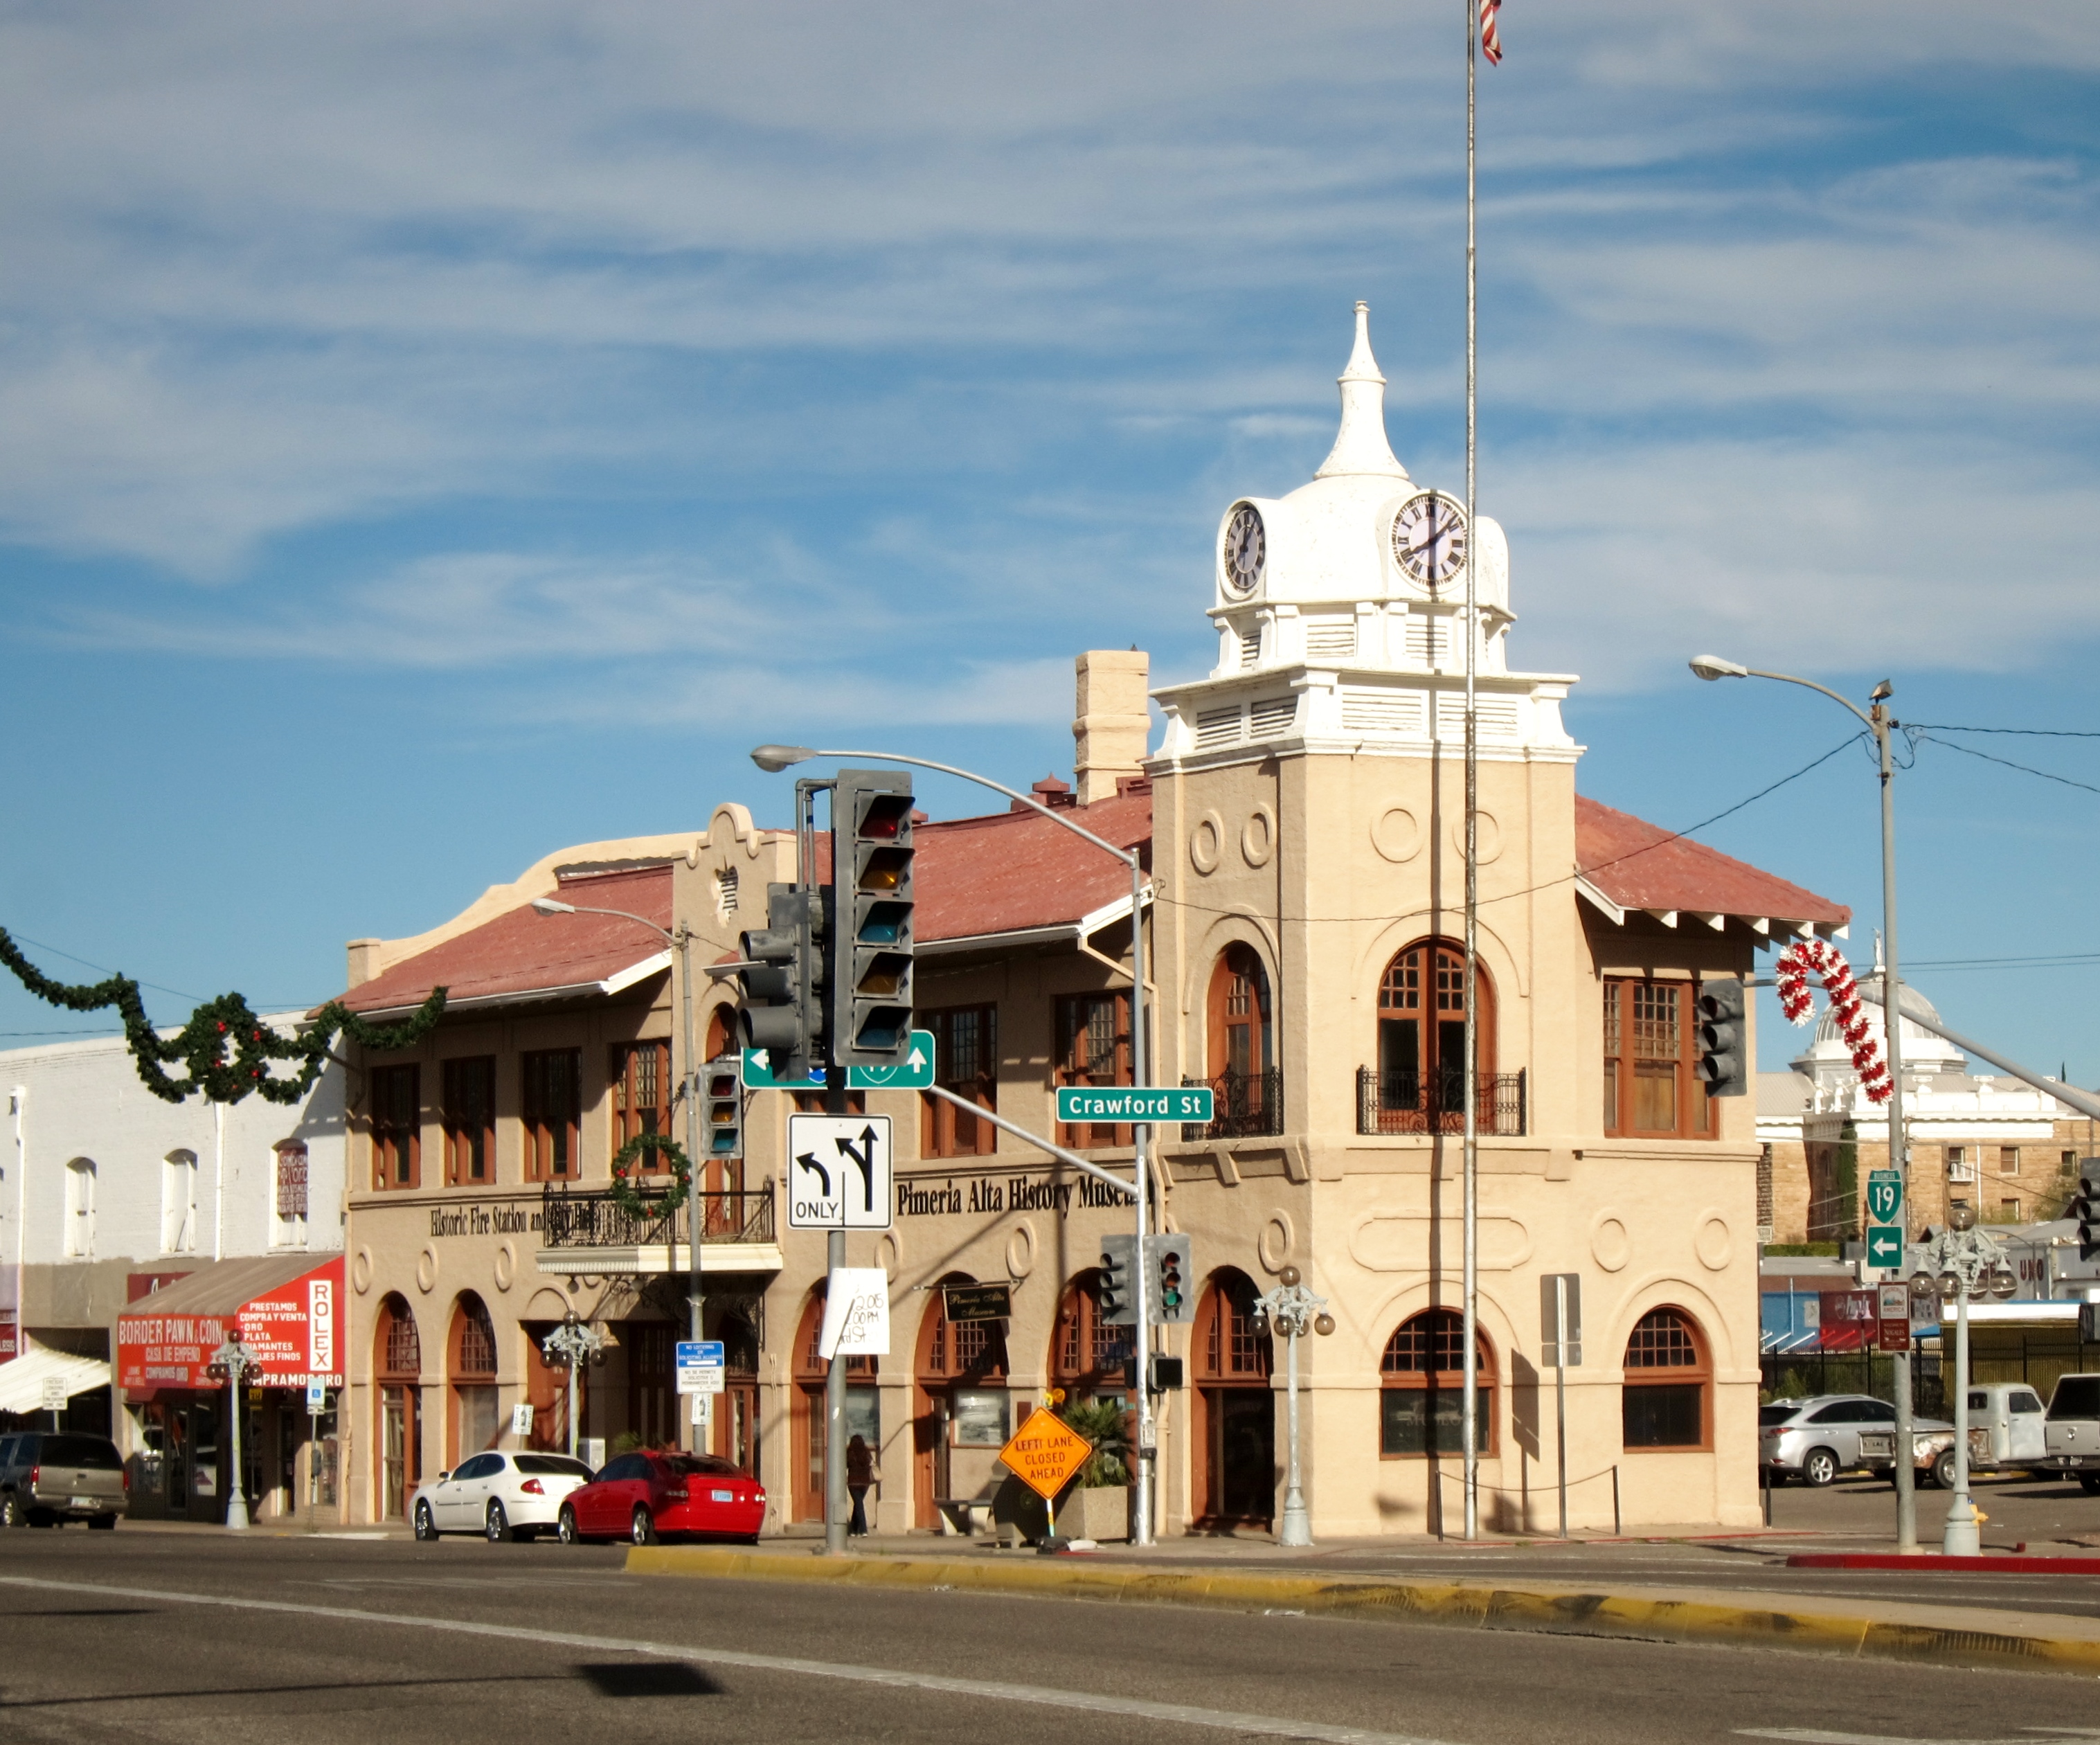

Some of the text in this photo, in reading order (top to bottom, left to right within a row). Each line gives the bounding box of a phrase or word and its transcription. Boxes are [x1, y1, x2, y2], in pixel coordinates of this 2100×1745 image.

[1070, 1095, 1201, 1114] Crawford St
[897, 1179, 962, 1216] Pimeria
[967, 1179, 1004, 1213] Alta
[1008, 1176, 1073, 1219] History
[1876, 1186, 1894, 1212] 19
[796, 1202, 838, 1219] ONLY
[431, 1207, 468, 1237] Historic
[470, 1205, 490, 1235] Fire
[492, 1203, 527, 1235] Station
[249, 1303, 297, 1312] PRESTAMOS
[240, 1313, 307, 1322] COMPRA Y VENTA
[119, 1320, 163, 1345] BORDER
[165, 1319, 194, 1344] PAWN
[199, 1319, 222, 1345] COIN
[244, 1323, 263, 1332] ORO
[314, 1285, 329, 1367] ROLEX
[244, 1332, 271, 1341] PLATA
[277, 1352, 300, 1361] FINOS
[1048, 1436, 1074, 1449] LANE
[1025, 1452, 1066, 1465] CLOSED
[1030, 1467, 1064, 1480] AHEAD
